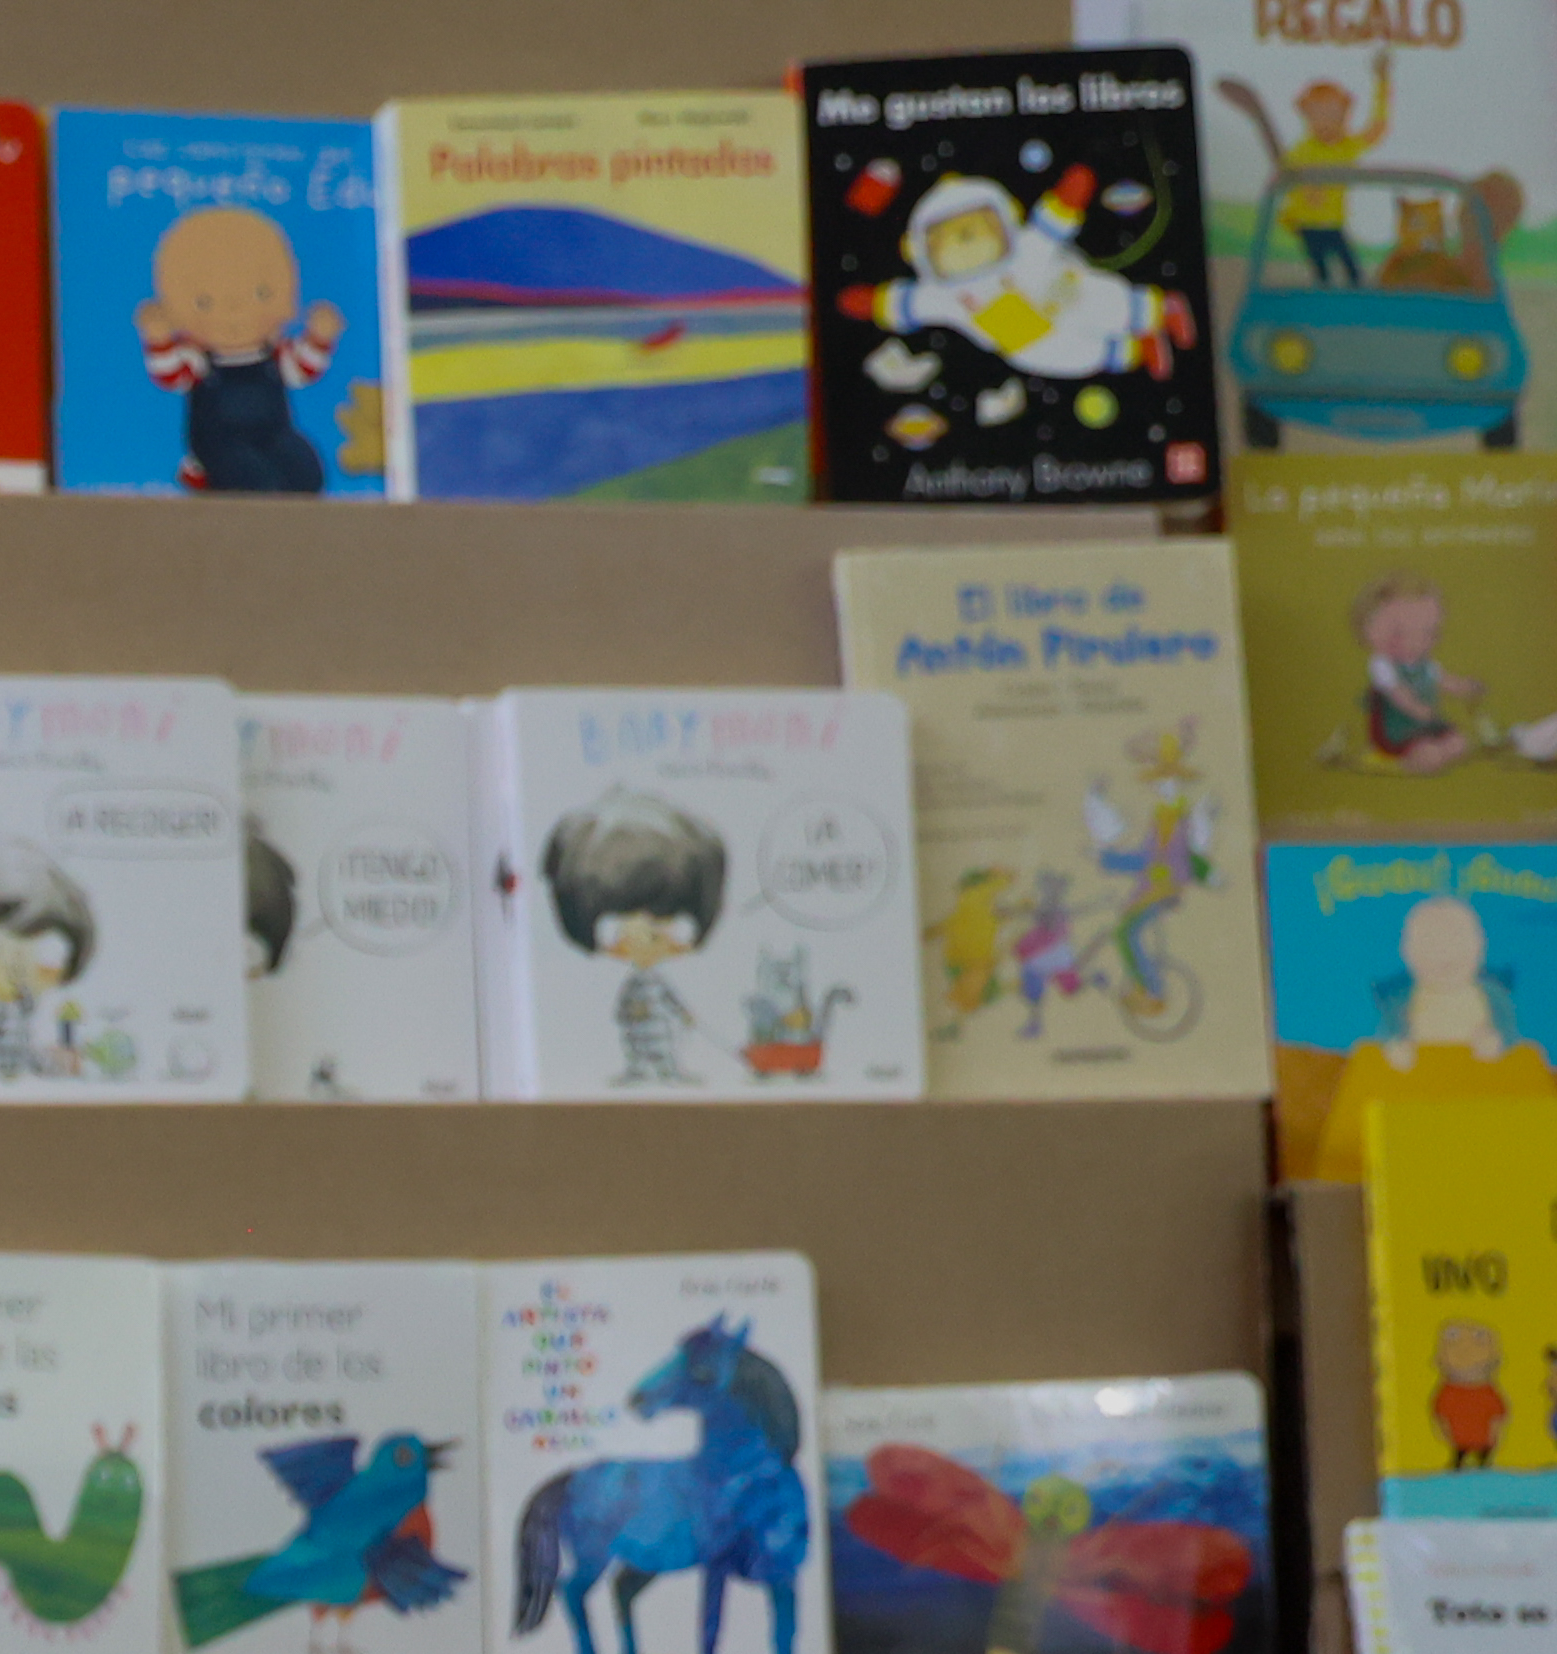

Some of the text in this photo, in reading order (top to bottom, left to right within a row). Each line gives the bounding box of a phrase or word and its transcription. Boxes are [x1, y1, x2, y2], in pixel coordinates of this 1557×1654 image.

[816, 71, 1186, 132] Me gustan los libros
[428, 140, 777, 190] Palabras pintadas
[957, 581, 1145, 621] El libro de
[195, 1298, 365, 1342] Mi primer
[196, 1345, 384, 1384] libro de los
[197, 1390, 345, 1430] colores
